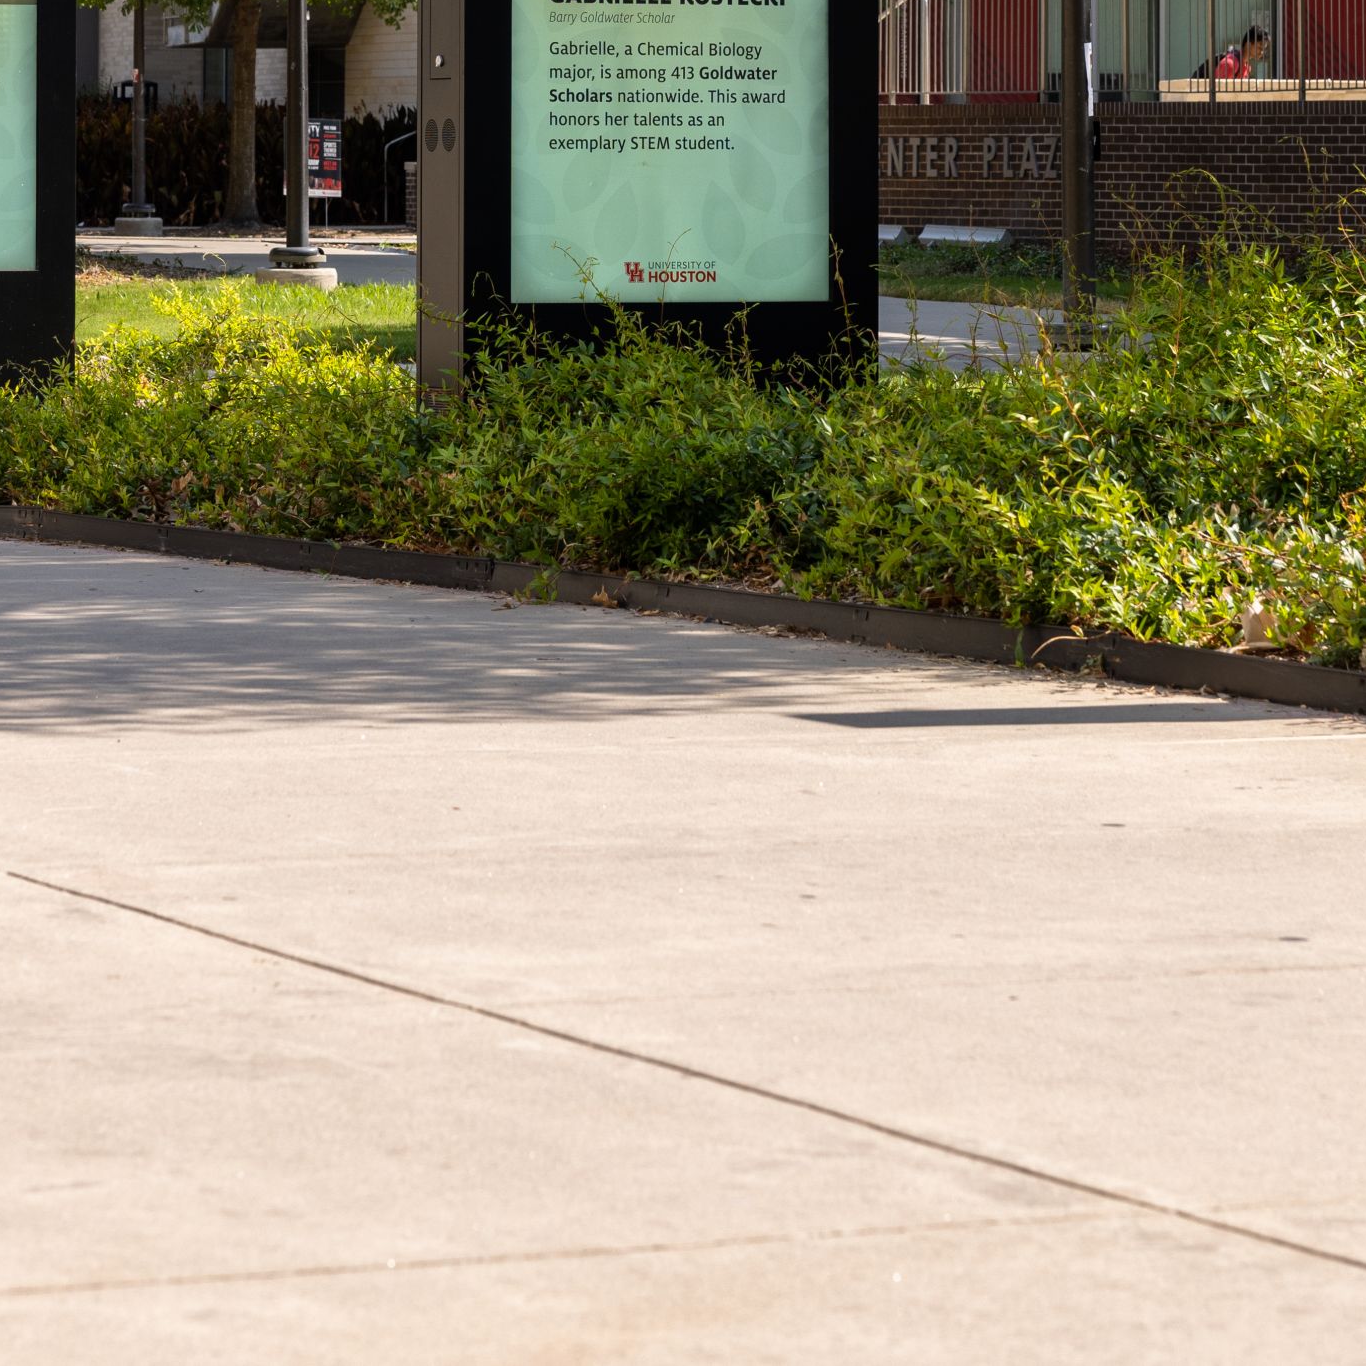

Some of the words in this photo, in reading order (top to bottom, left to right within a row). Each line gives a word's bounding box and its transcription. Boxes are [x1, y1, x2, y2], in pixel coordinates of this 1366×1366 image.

[549, 11, 578, 26] Barry
[580, 10, 634, 24] Goldwater
[636, 12, 675, 24] Scholar
[549, 40, 619, 58] Gabrielle,
[624, 45, 633, 56] a
[637, 41, 703, 56] Chemical
[709, 42, 762, 60] Biology
[549, 68, 595, 82] major,
[600, 68, 612, 79] is
[616, 68, 666, 83] among
[671, 66, 694, 80] 413
[699, 65, 778, 80] Goldwater
[549, 88, 613, 103] Scholars
[618, 88, 703, 103] nationwide.
[708, 89, 737, 103] This
[742, 89, 785, 104] award
[549, 111, 600, 126] honors
[605, 111, 629, 126] her
[633, 112, 683, 126] talents
[688, 115, 703, 127] as
[707, 115, 724, 126] an
[549, 135, 626, 153] exemplary
[630, 136, 670, 150] STEM
[675, 135, 735, 150] student.
[648, 260, 702, 270] UNIVERSITY
[703, 261, 716, 269] OF
[648, 270, 716, 283] HOUSTON
